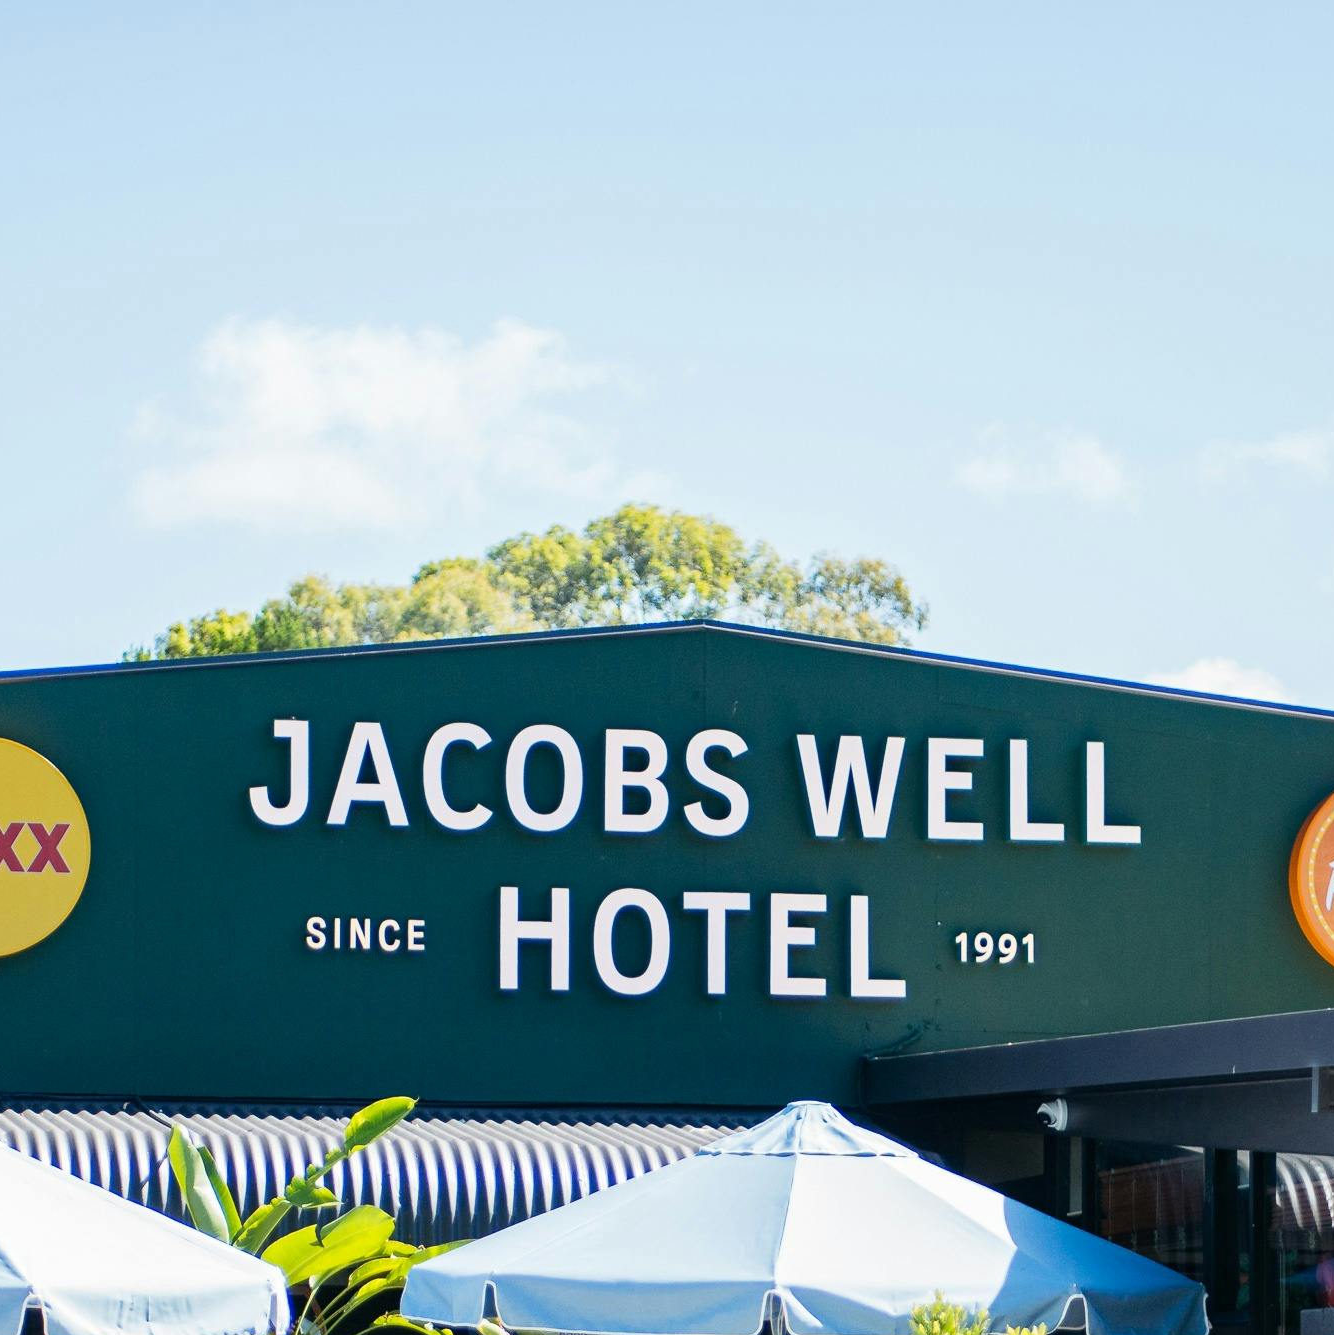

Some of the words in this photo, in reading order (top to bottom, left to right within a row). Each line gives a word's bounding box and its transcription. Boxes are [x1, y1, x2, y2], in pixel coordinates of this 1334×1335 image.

[249, 719, 749, 837] JACOBS
[796, 734, 1142, 844] WELL
[306, 916, 426, 952] SINCE
[499, 886, 907, 998] HOTEL
[955, 931, 1035, 964] 1991
